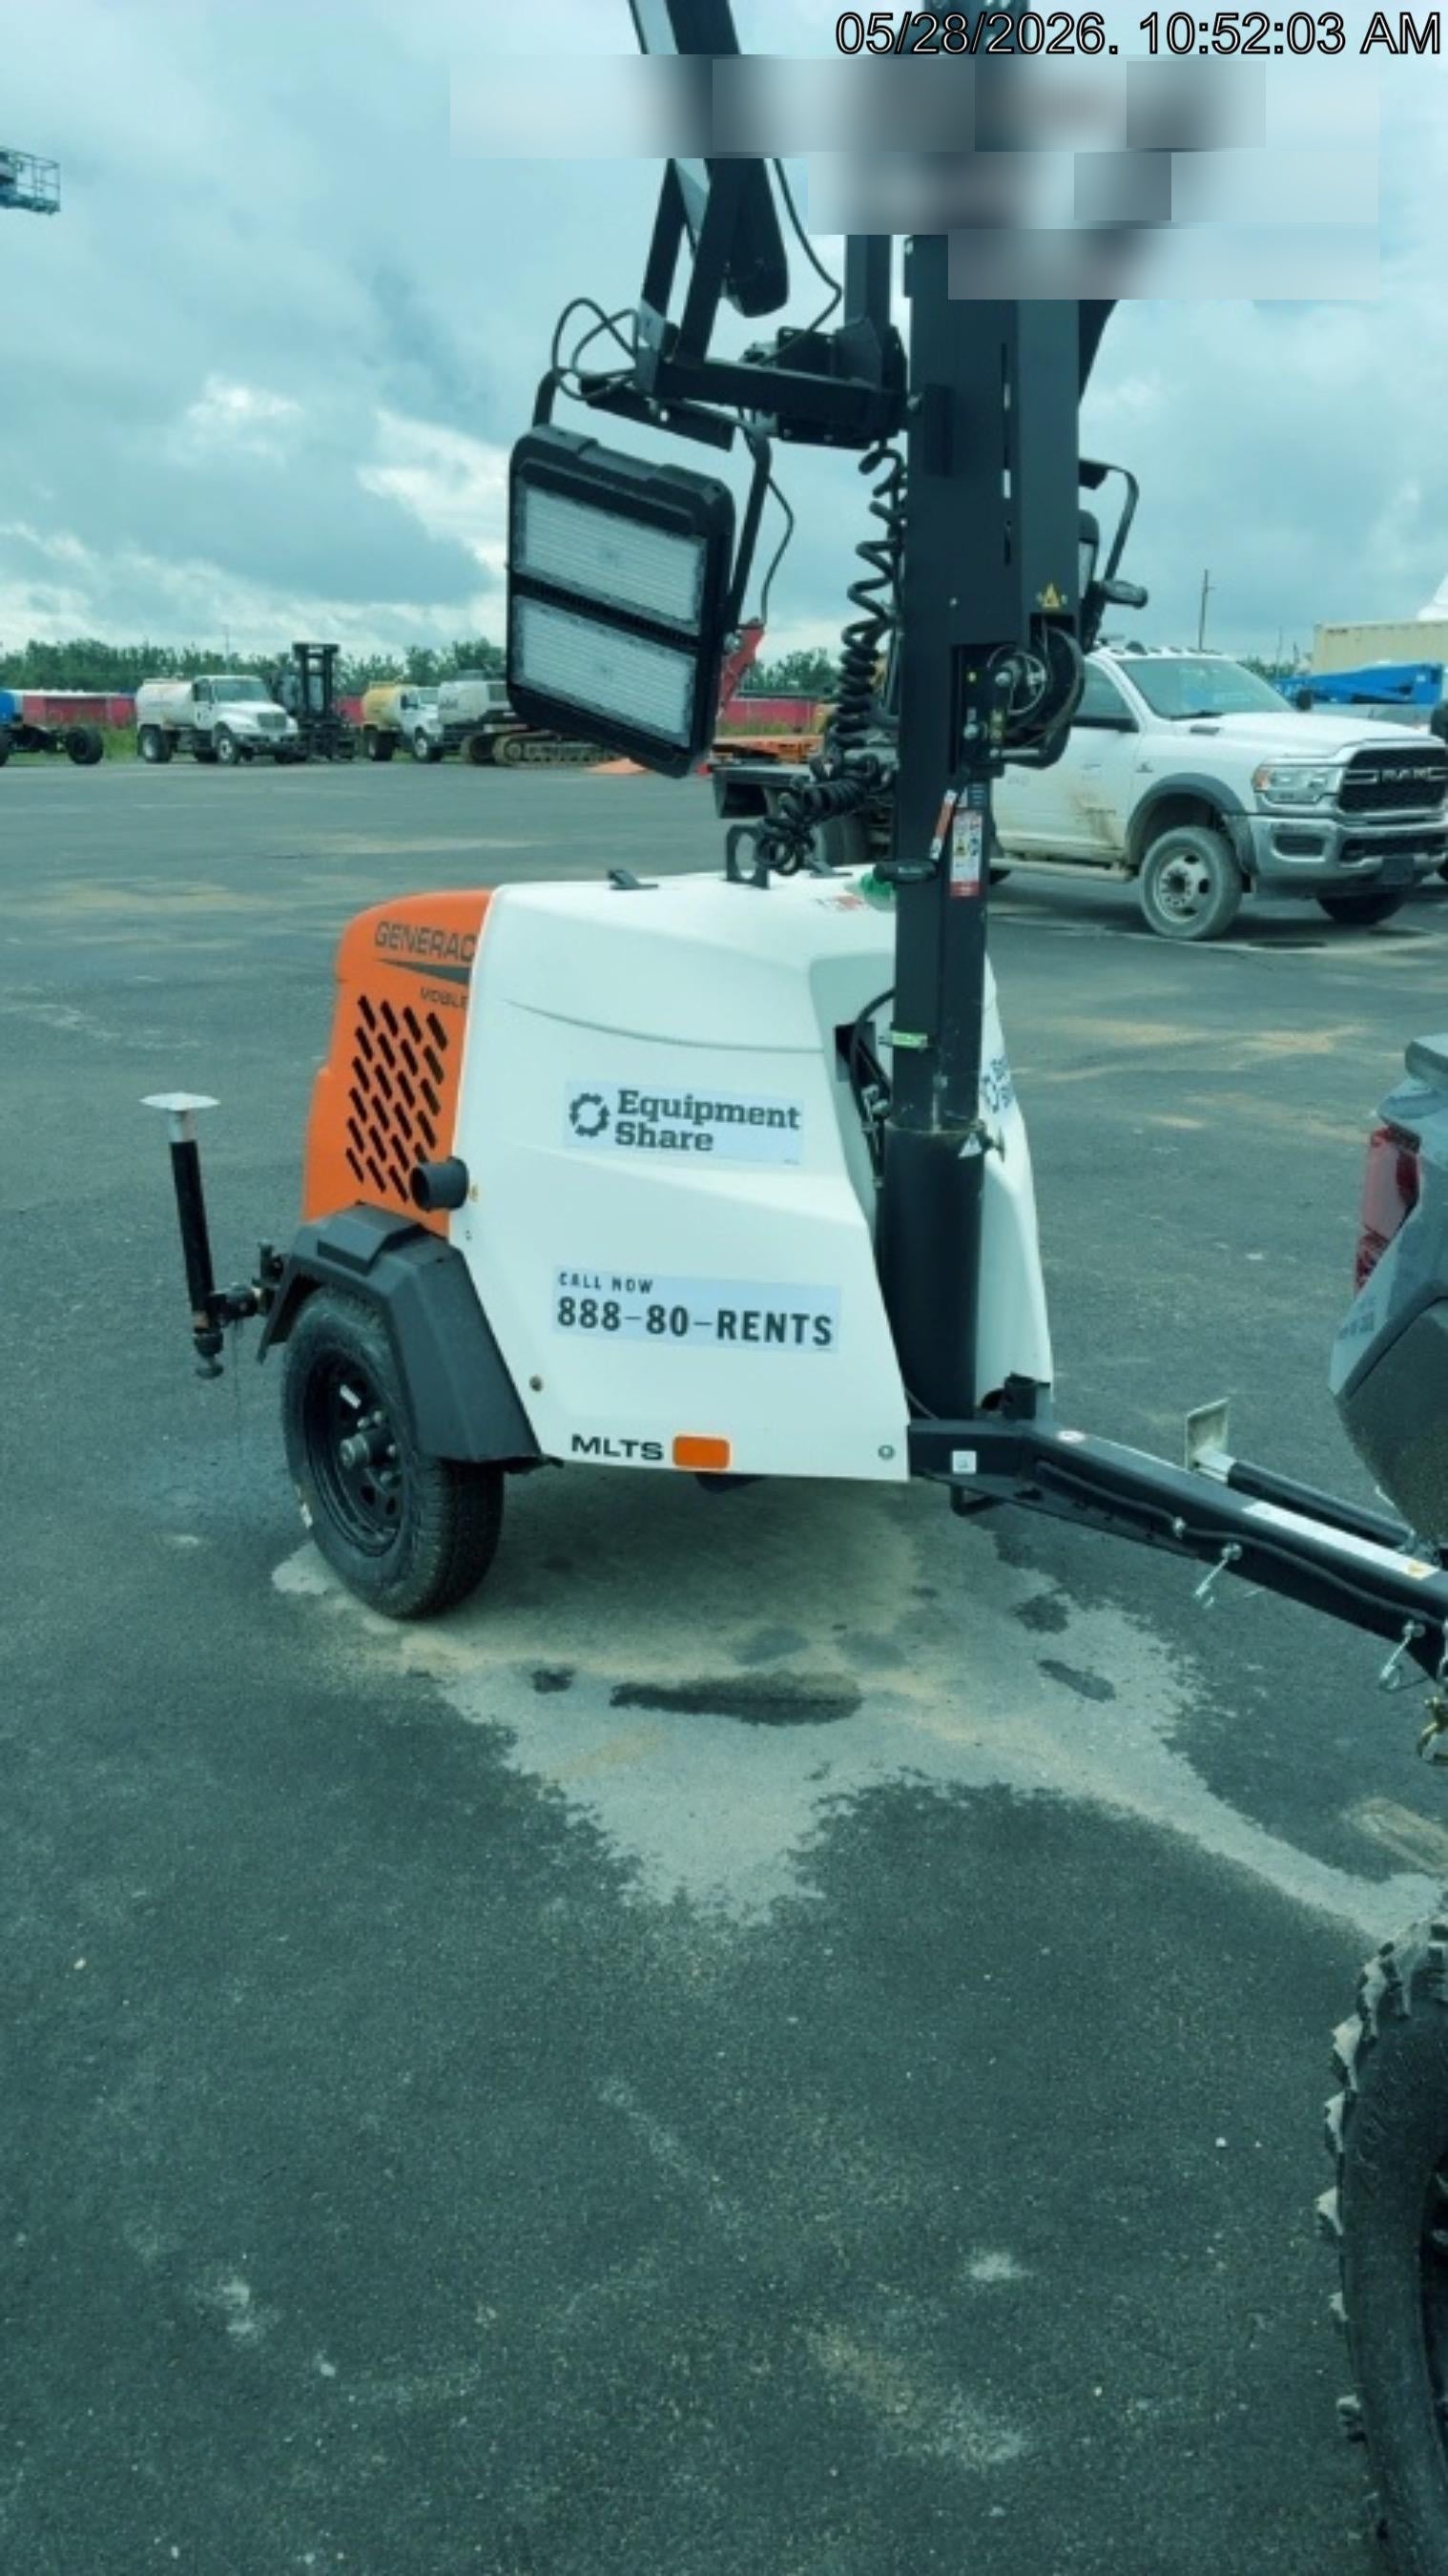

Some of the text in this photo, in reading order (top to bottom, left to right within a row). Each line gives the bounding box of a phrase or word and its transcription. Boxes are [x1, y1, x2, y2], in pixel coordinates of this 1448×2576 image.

[375, 921, 476, 962] GENERAC
[616, 1089, 801, 1131] Equipment
[614, 1121, 714, 1152] Share
[558, 1272, 653, 1294] CALL NOW
[557, 1296, 833, 1346] 888-80-RENTS
[571, 1433, 665, 1462] MLTS
